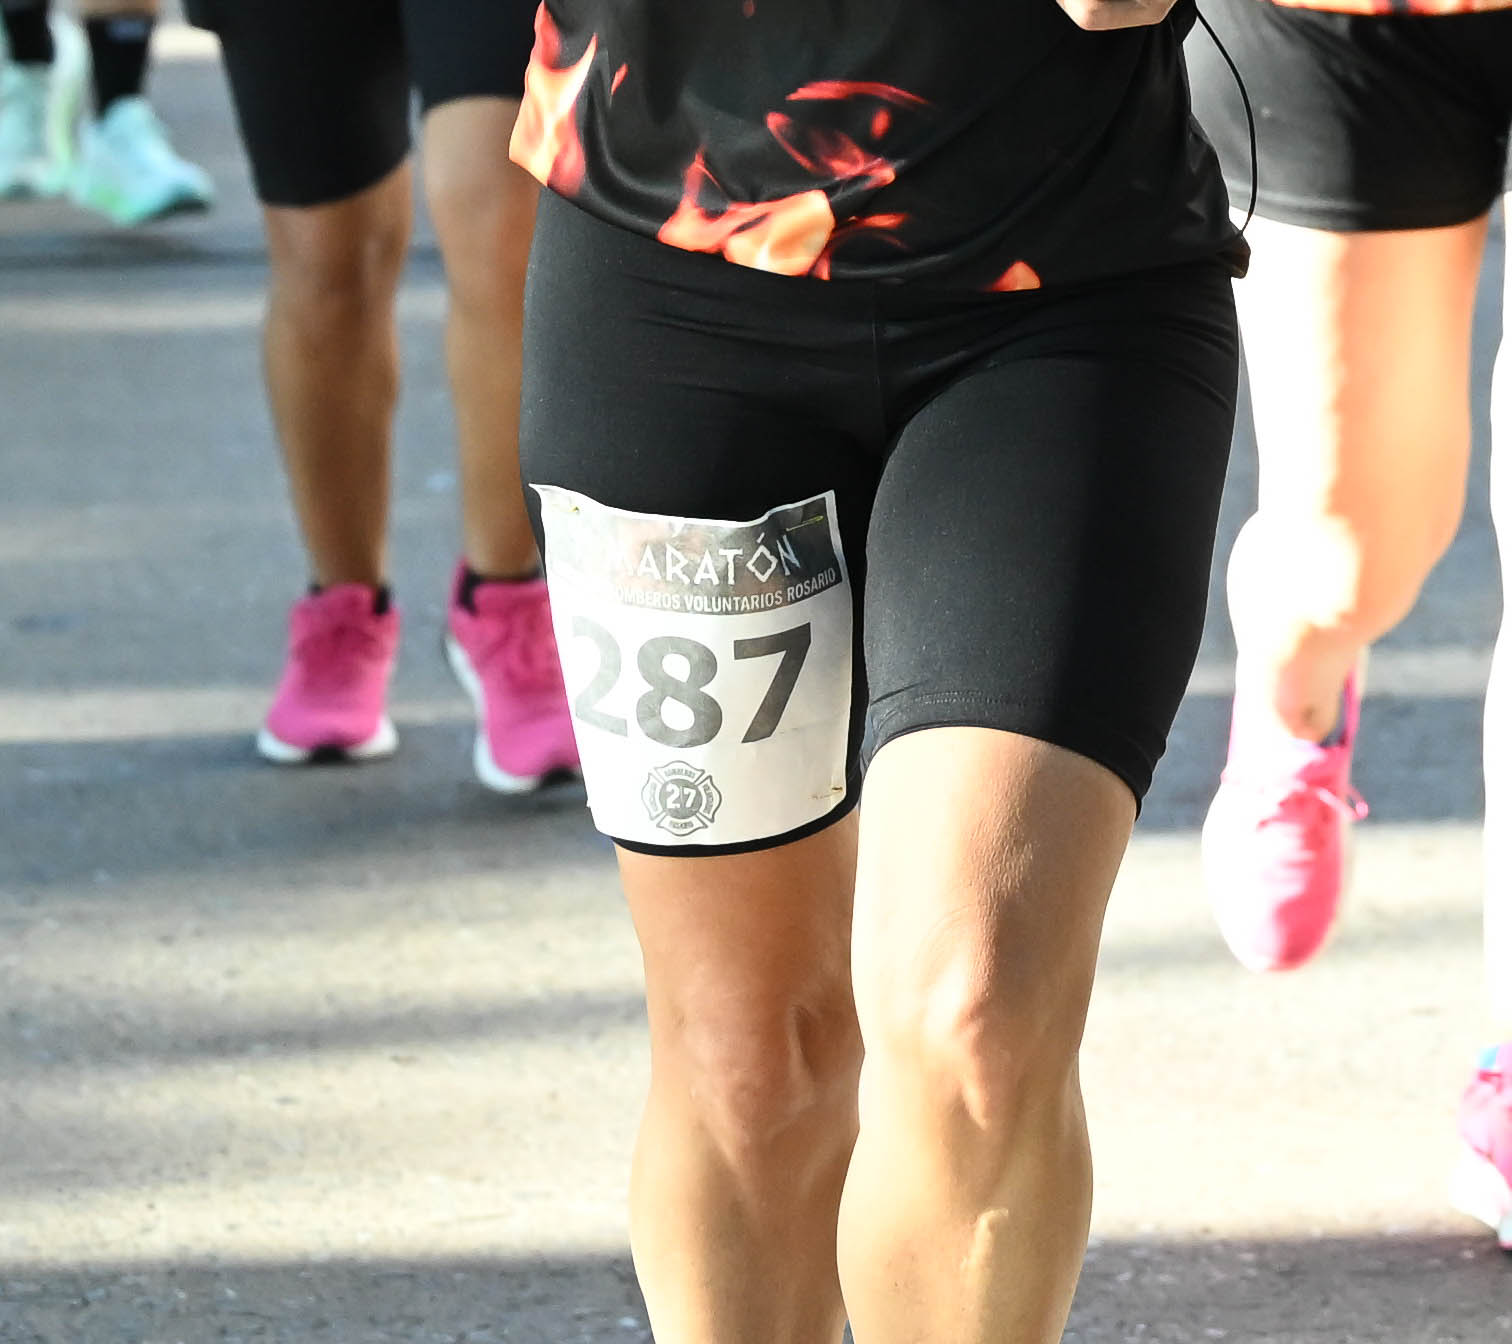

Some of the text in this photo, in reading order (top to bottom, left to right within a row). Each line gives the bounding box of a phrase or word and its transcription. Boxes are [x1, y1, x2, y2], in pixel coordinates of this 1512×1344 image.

[615, 566, 836, 613] OMBEROS VOLUNTARIOS ROSARIO
[571, 615, 812, 749] 287
[666, 783, 697, 809] 27
